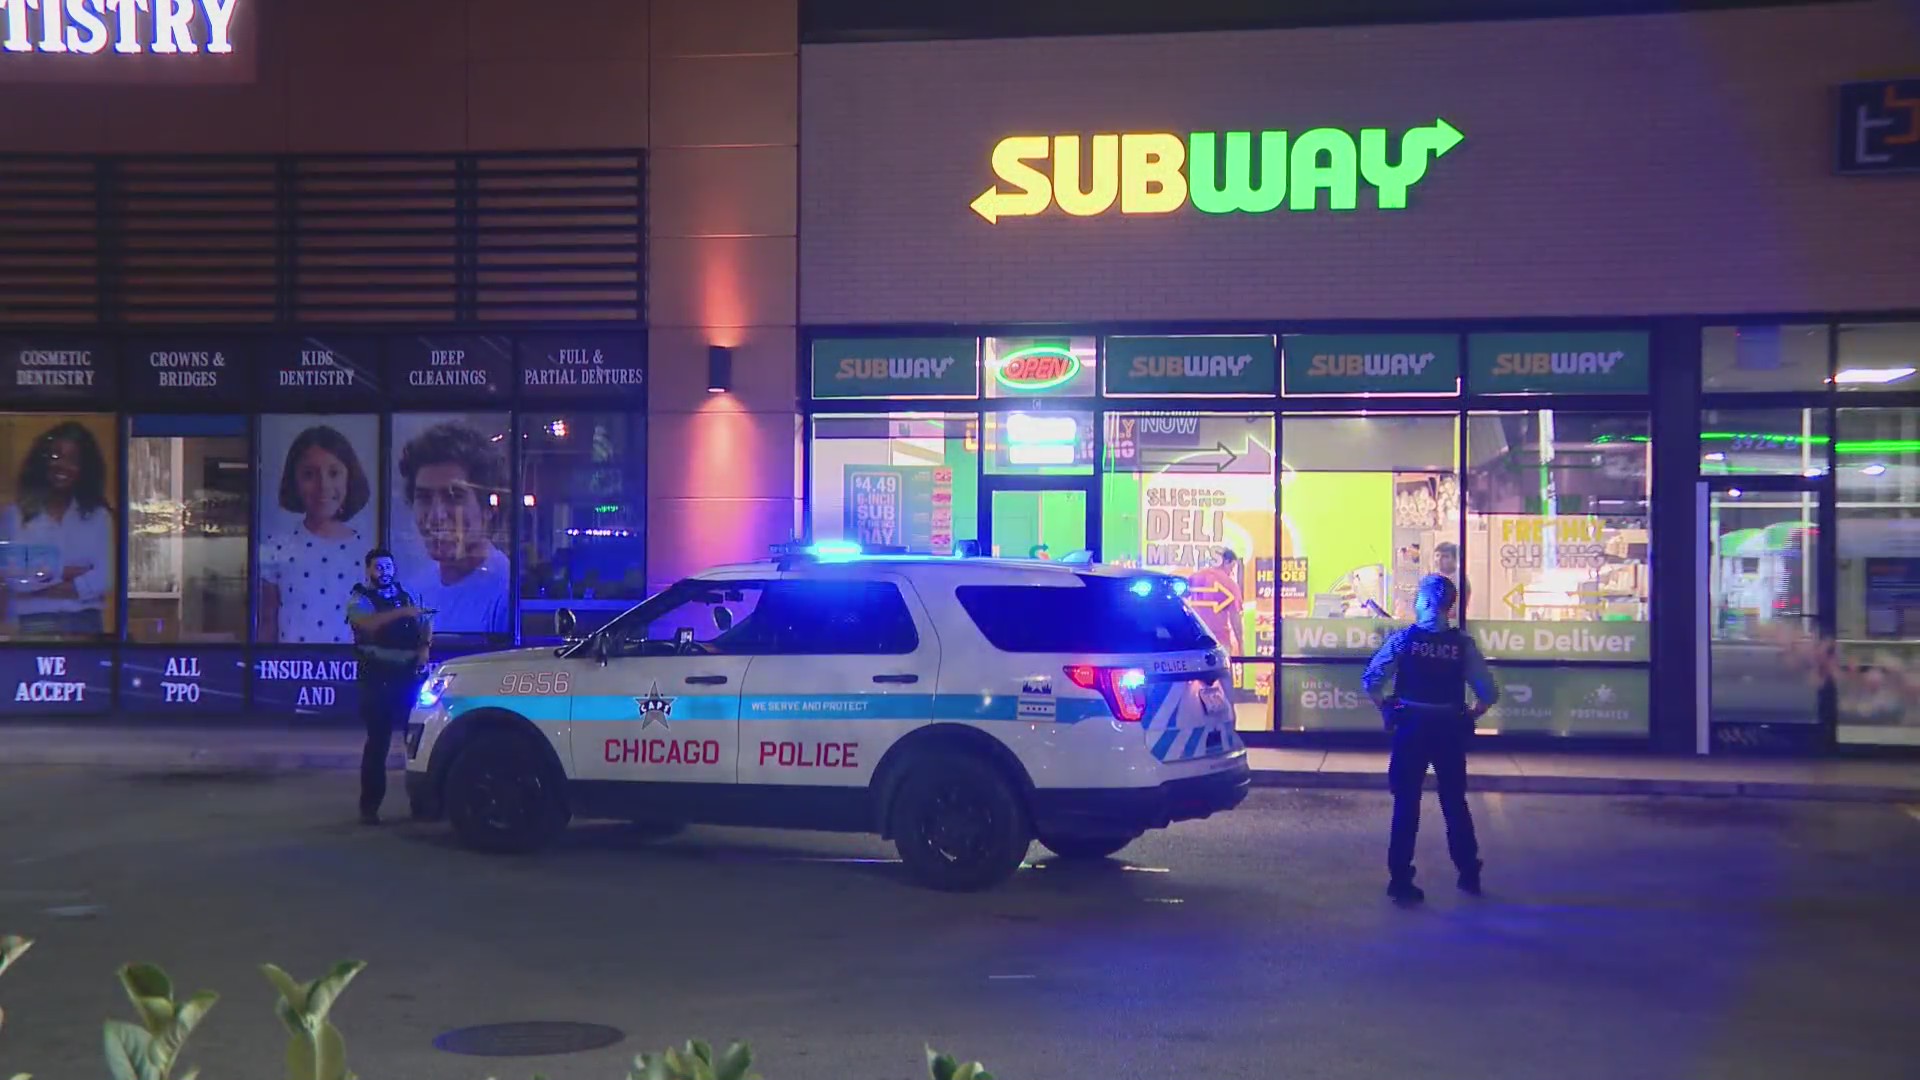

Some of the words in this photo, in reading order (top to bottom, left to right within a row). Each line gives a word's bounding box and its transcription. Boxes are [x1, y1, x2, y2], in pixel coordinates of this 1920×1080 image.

[970, 118, 1464, 225] SUBWAY
[19, 351, 92, 367] COSMETIC
[149, 352, 209, 368] CROWNS
[212, 352, 226, 368] &
[300, 351, 335, 367] KIDS
[430, 350, 466, 367] DEEP
[558, 349, 590, 365] FULL
[593, 349, 604, 364] &
[1128, 354, 1254, 379] SUBWAY
[1308, 352, 1436, 377] SUBWAY
[1492, 351, 1627, 376] SUBWAY
[523, 367, 579, 386] PARTIAL
[580, 367, 644, 385] DENTURES
[834, 355, 956, 380] SUBWAY
[1007, 358, 1069, 381] OPEN
[16, 370, 96, 387] DENTISTRY
[158, 372, 218, 388] BRIDGES
[279, 370, 356, 388] DENTISTRY
[408, 369, 488, 387] CLEANINGS
[1140, 417, 1199, 434] NOW
[855, 476, 897, 493] $4.49
[1147, 488, 1226, 507] SLICING
[857, 505, 896, 520] SUB
[1146, 510, 1224, 542] DELI
[1501, 519, 1606, 543] FREHLY
[1146, 544, 1220, 566] MEATS
[1500, 545, 1605, 569] SLIING
[1256, 571, 1307, 583] HEOES
[1295, 626, 1338, 648] We
[1480, 629, 1525, 651] We
[1534, 629, 1635, 652] Deliver
[1410, 642, 1459, 659] POLICE
[36, 656, 66, 676] WE
[164, 656, 201, 677] ALL
[1153, 662, 1188, 672] POLICE
[14, 682, 86, 702] ACCEPT
[498, 672, 568, 694] 9656
[163, 684, 200, 703] PPO
[296, 686, 336, 706] AND
[1300, 688, 1358, 709] eats
[751, 702, 765, 711] WE
[768, 701, 800, 711] SERVE
[802, 701, 821, 711] AND
[822, 700, 868, 711] PROTECT
[604, 738, 719, 766] CHICAGO
[759, 741, 859, 767] POLICE
